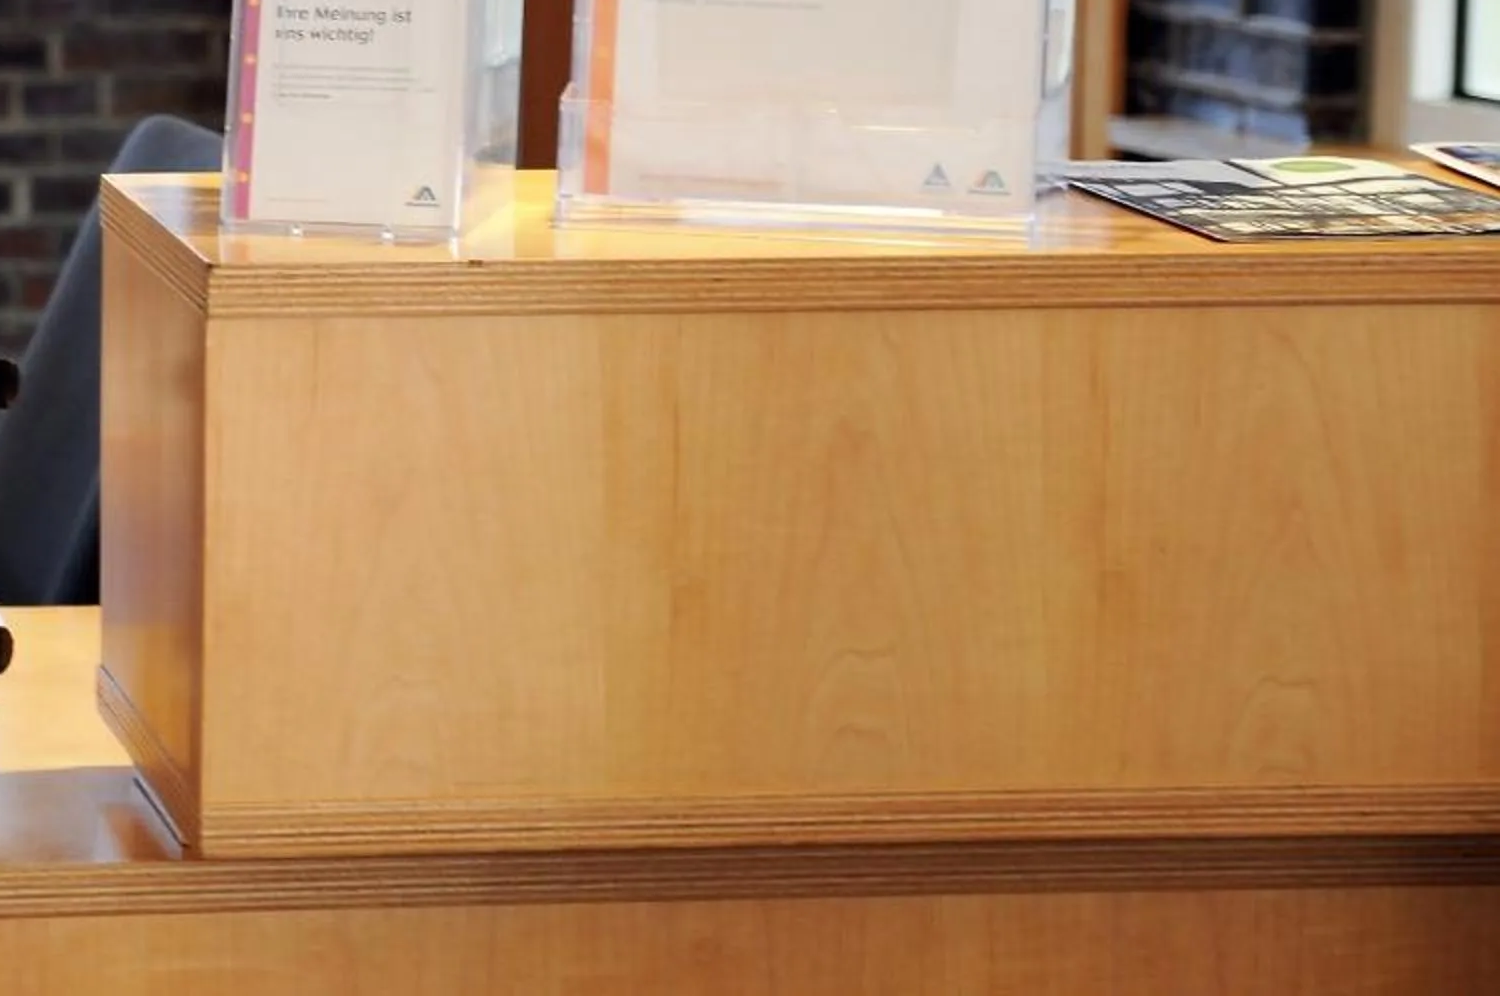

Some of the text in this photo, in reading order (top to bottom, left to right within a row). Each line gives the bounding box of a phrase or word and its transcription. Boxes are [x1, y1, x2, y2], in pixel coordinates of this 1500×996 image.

[276, 5, 413, 25] Ihre Meinung ist
[309, 27, 375, 45] wichtig!
